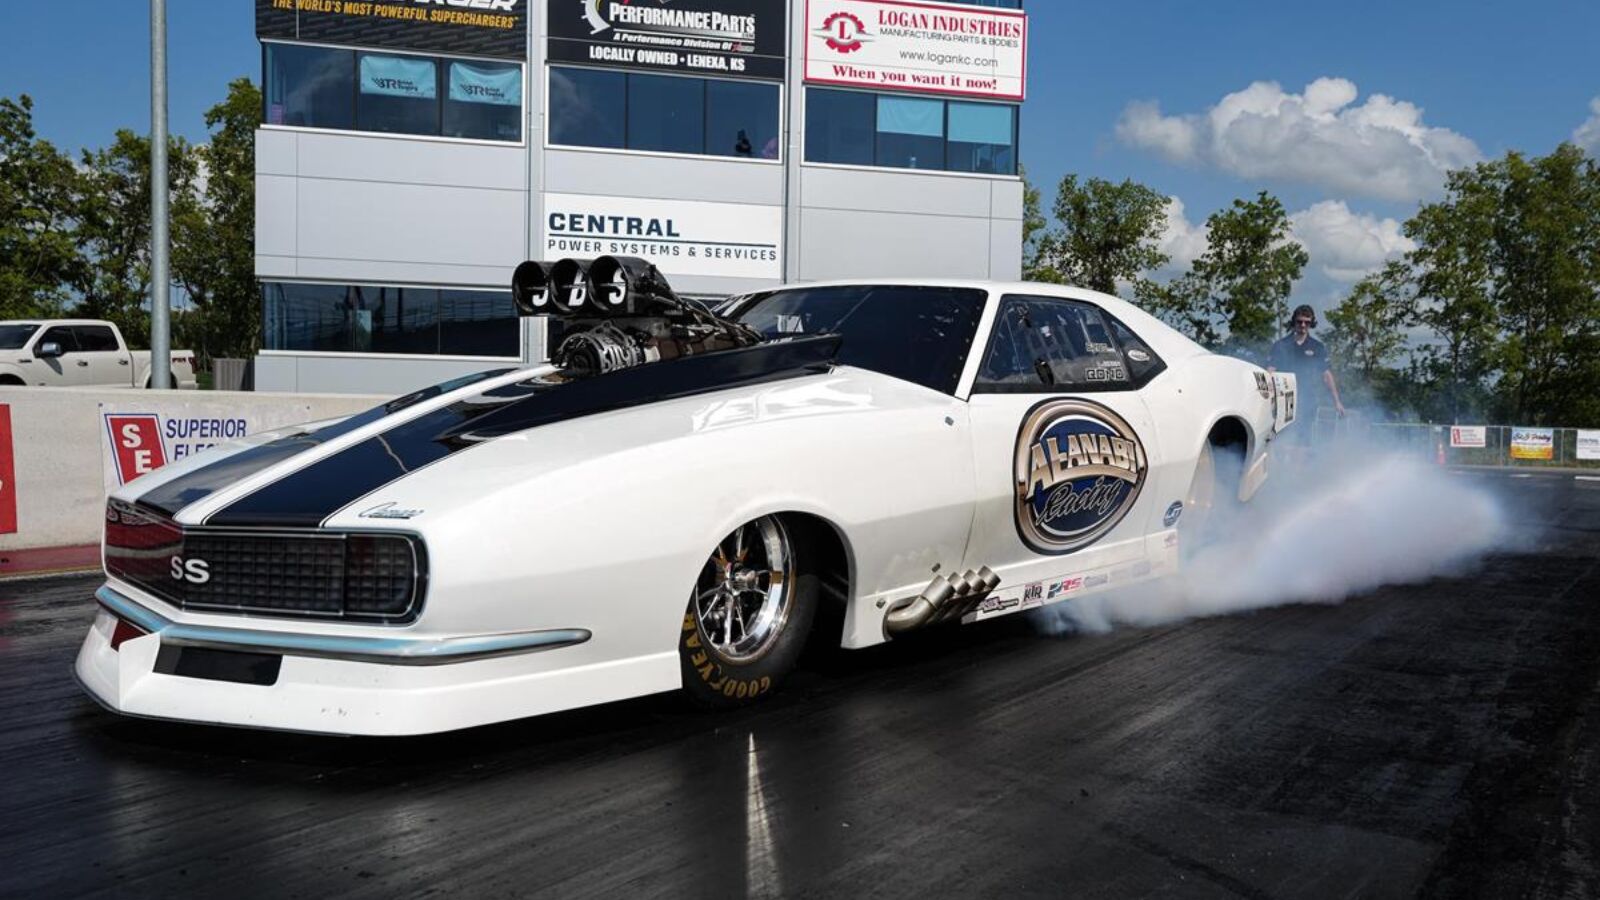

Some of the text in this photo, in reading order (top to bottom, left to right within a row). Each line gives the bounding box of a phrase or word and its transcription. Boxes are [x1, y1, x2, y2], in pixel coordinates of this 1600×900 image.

[272, 0, 293, 9] THE
[297, 0, 341, 13] WORLD'S
[344, 2, 373, 15] MOST
[374, 5, 428, 20] POWERFUL
[879, 10, 1021, 38] LOGAN INDUSTRIES
[613, 33, 621, 41] A
[621, 33, 683, 46] Performance
[683, 40, 721, 49] Division
[880, 28, 1019, 48] MANUFACTURING PARTS & BODIES
[589, 45, 745, 71] LOCALLY OWNED LENEXA, KS
[899, 50, 998, 67] www.logankc.com
[832, 64, 997, 90] When you want it now!
[549, 212, 681, 238] CENTRAL
[548, 239, 777, 261] POWER SYSTEMS & SERVICES
[122, 423, 142, 448] S
[166, 419, 246, 439] SUPERIOR
[134, 450, 152, 474] E
[171, 555, 210, 584] SS
[683, 612, 771, 698] GOODYEAR
